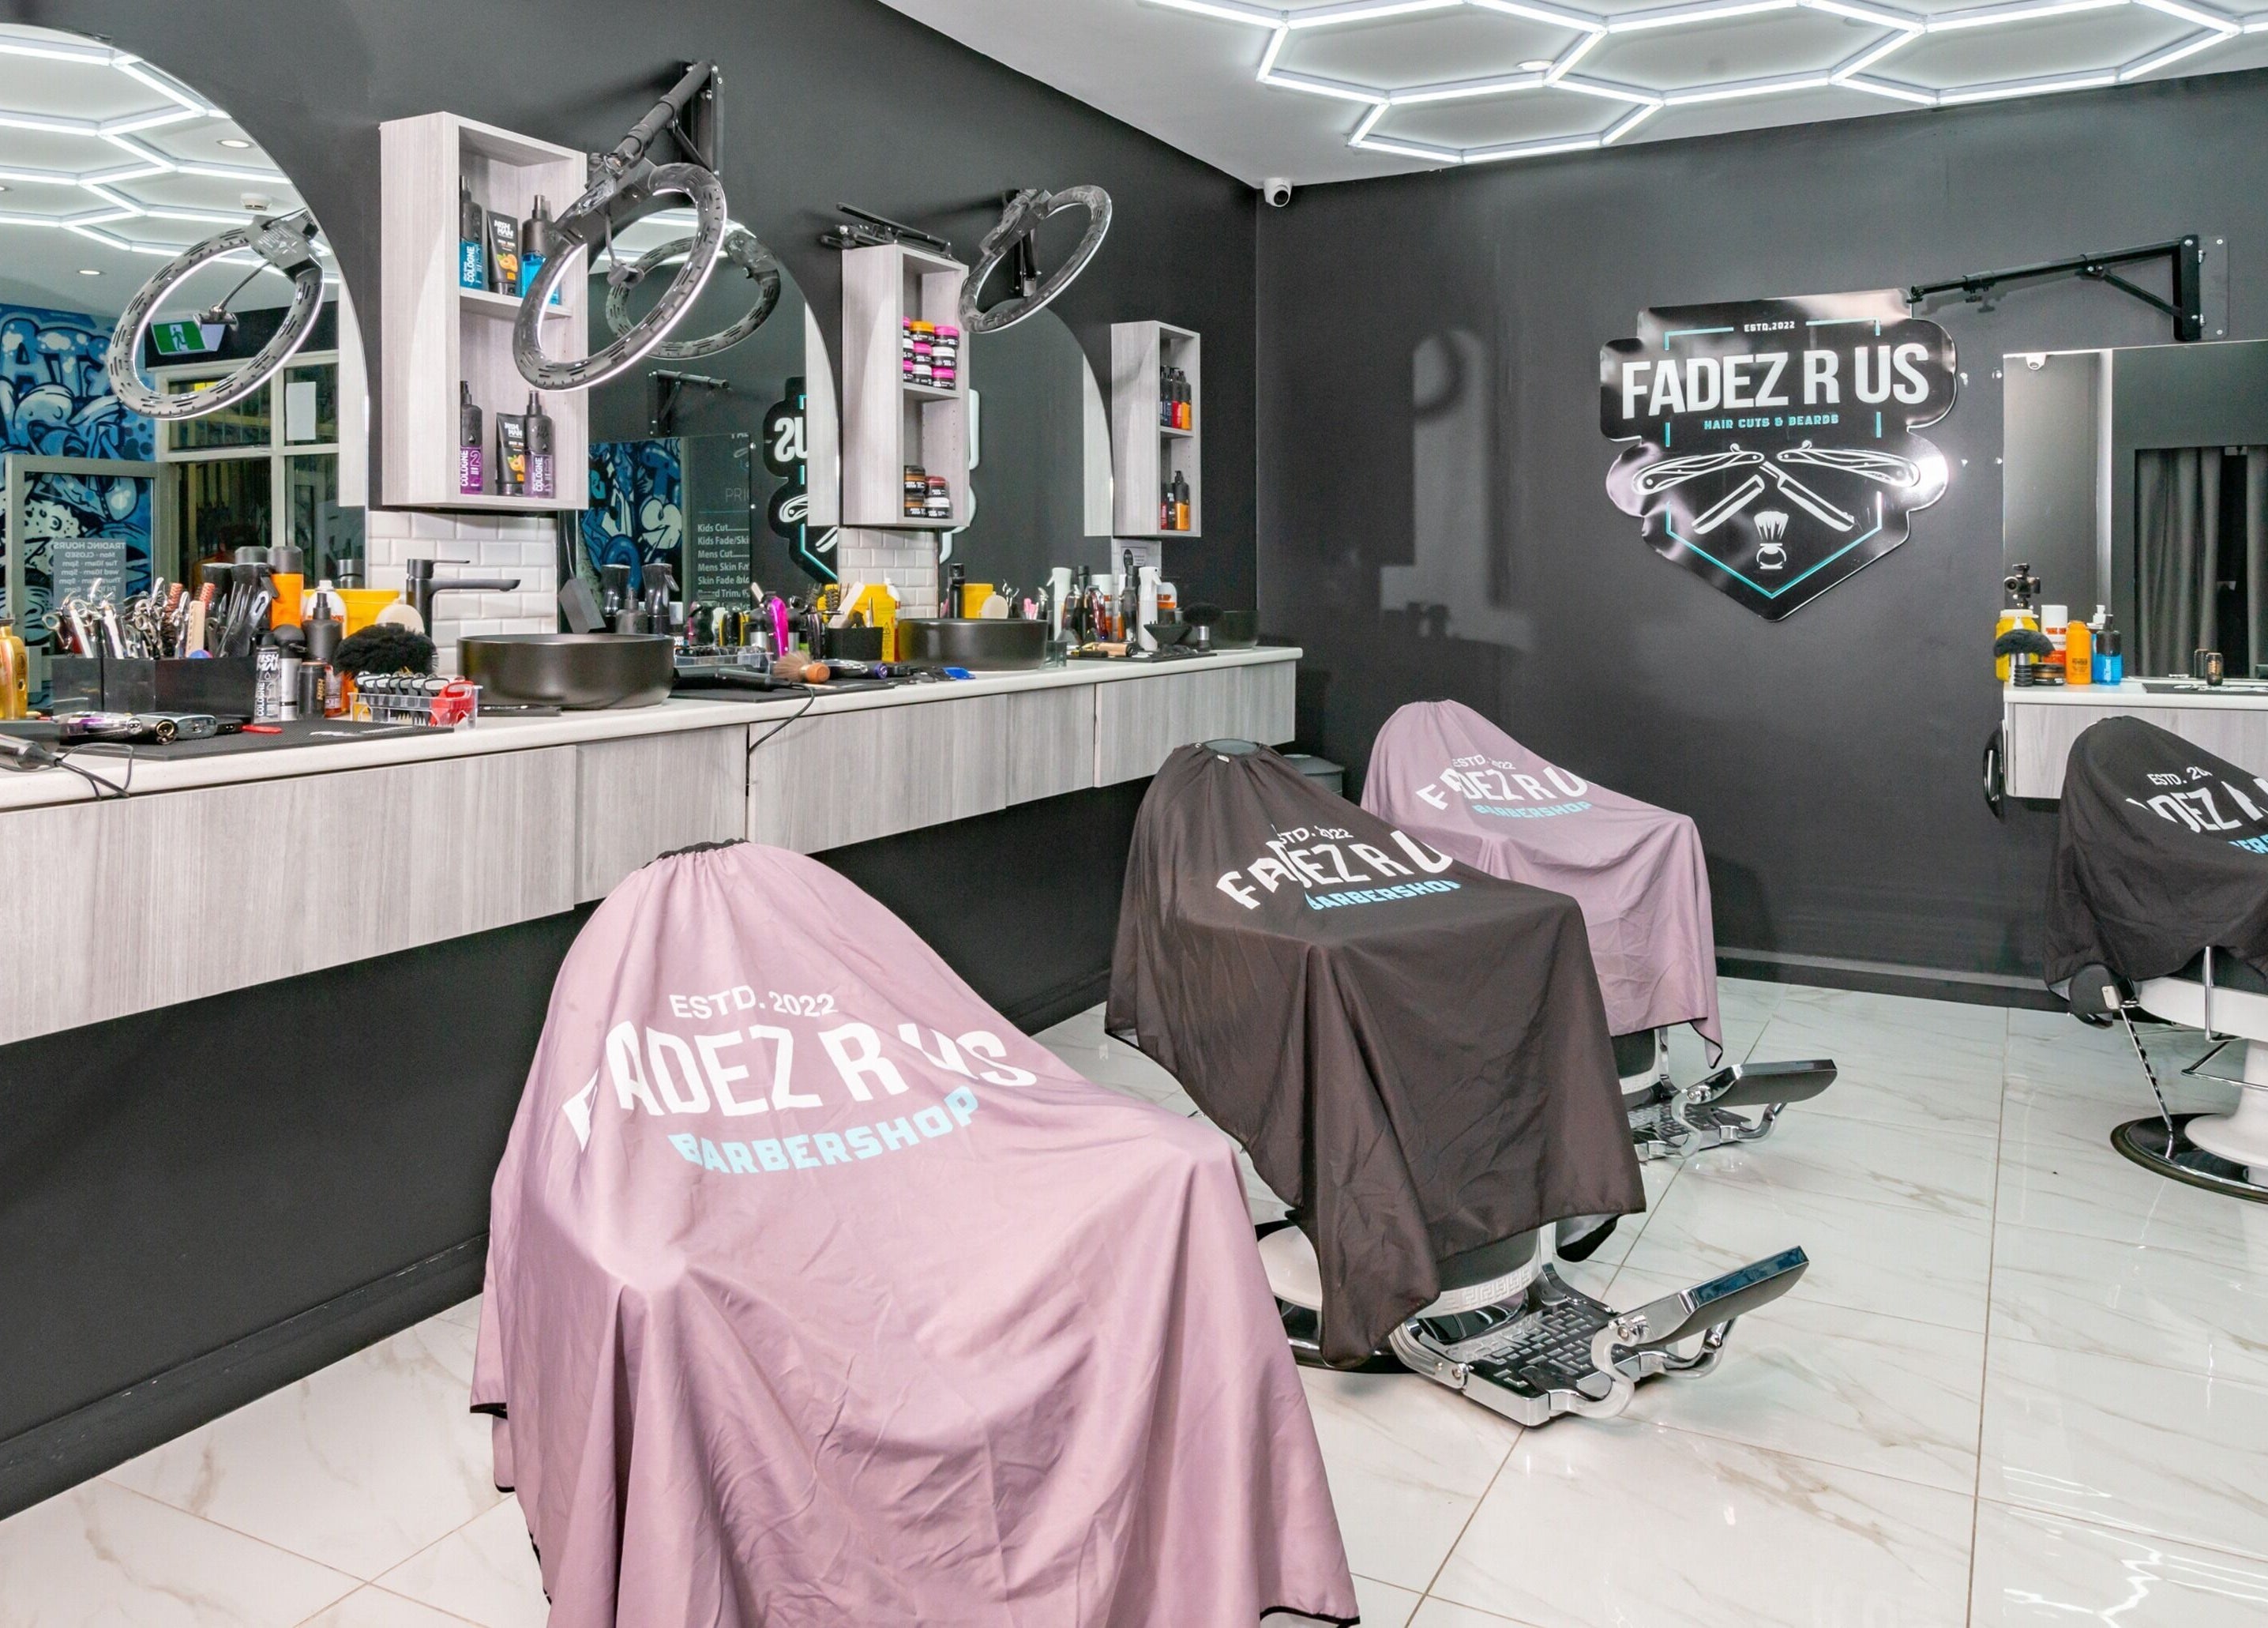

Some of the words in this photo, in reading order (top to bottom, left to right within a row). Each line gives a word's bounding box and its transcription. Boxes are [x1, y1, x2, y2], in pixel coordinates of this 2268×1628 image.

[1622, 352, 1789, 419] FADEZ
[1804, 349, 1840, 404] R
[1855, 343, 1929, 404] US
[1704, 419, 1733, 430] HAIR
[1738, 418, 1770, 428] CUTS
[1788, 415, 1838, 427] BEARDS
[697, 536, 714, 545] Kids
[698, 550, 718, 558] Mens
[697, 576, 714, 585] Skin
[715, 575, 734, 585] Fade
[698, 563, 718, 572] Mens
[719, 562, 736, 571] Skin
[255, 682, 265, 716] COLOGNE
[1511, 774, 1556, 800] R
[1348, 844, 1414, 877] R
[669, 985, 766, 1020] ESTD.
[771, 991, 839, 1017] 2022
[818, 1023, 909, 1102] R
[667, 1085, 979, 1175] BARBERSHOP
